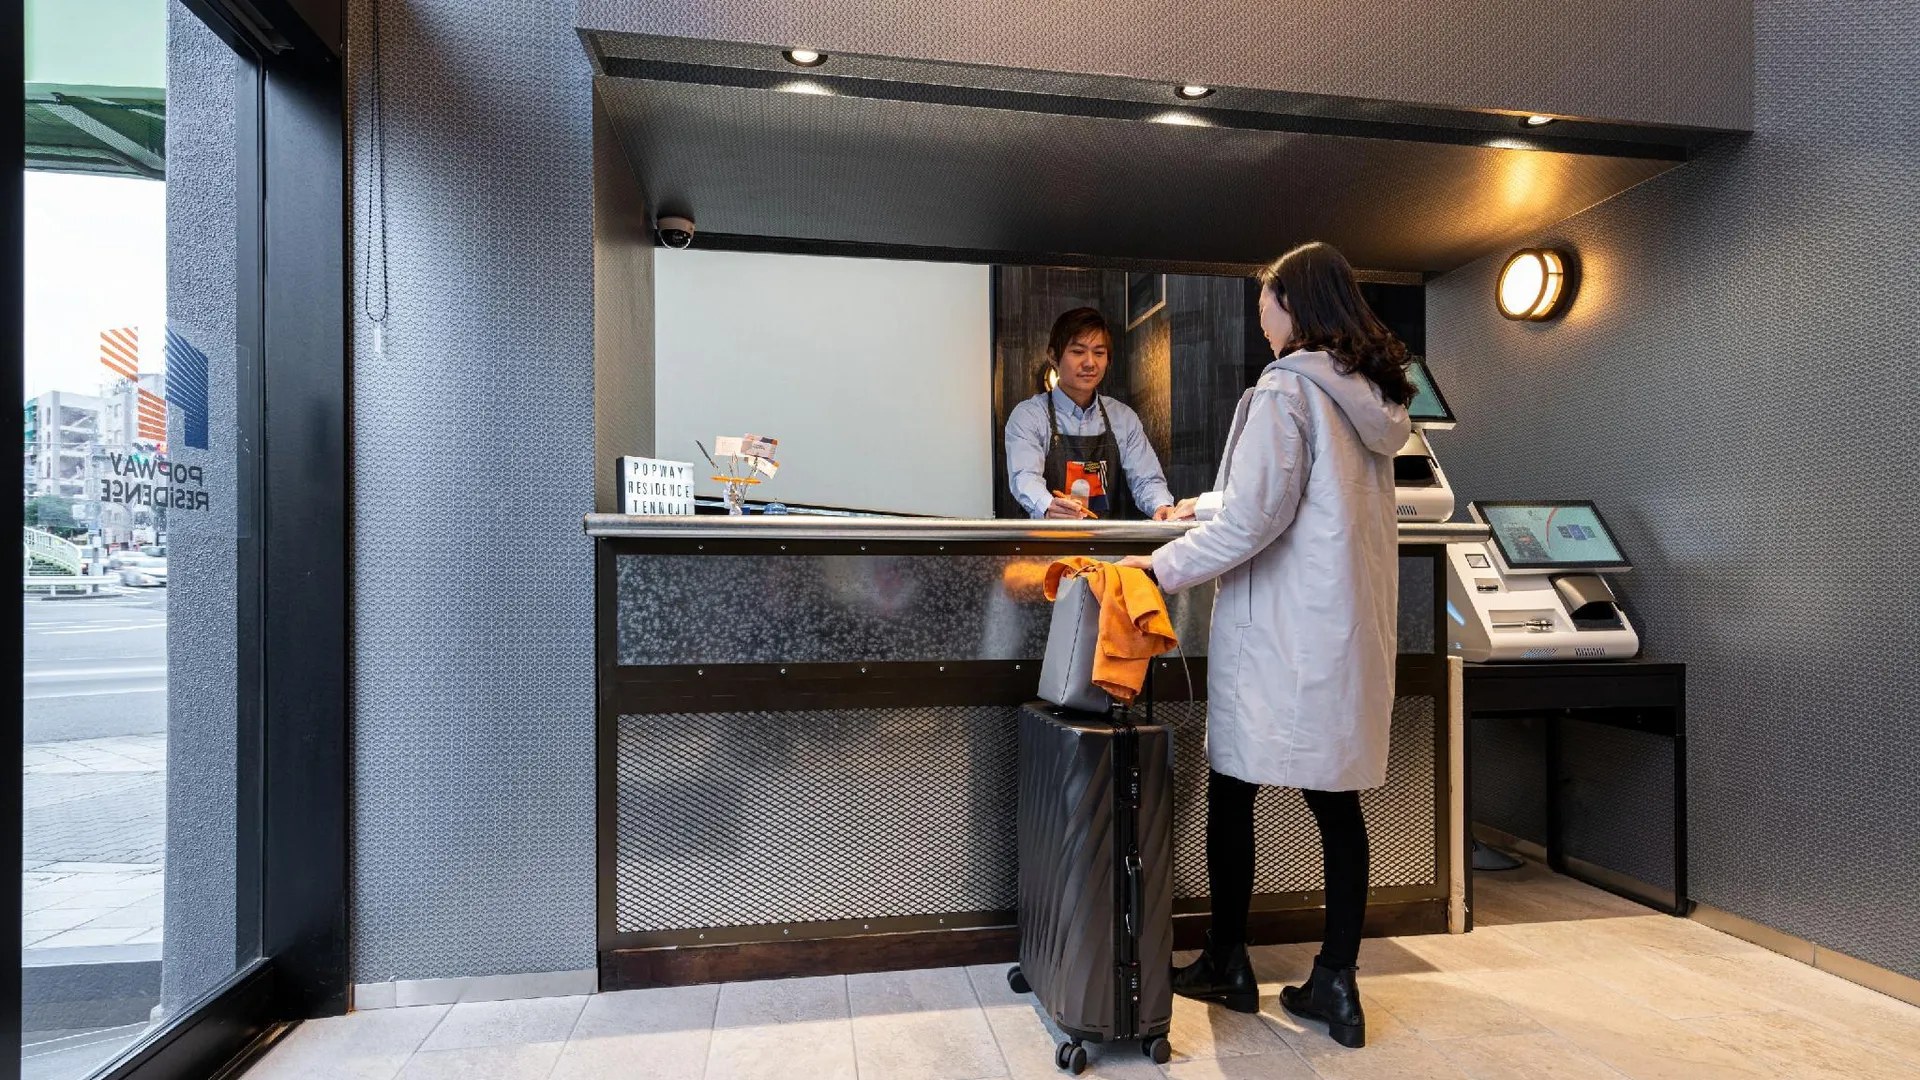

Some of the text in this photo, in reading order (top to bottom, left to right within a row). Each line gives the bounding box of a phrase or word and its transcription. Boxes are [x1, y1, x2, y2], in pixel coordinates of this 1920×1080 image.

[633, 462, 684, 479] POPWAY
[628, 481, 690, 498] RESIDENCE
[633, 499, 687, 515] TENNOJI
